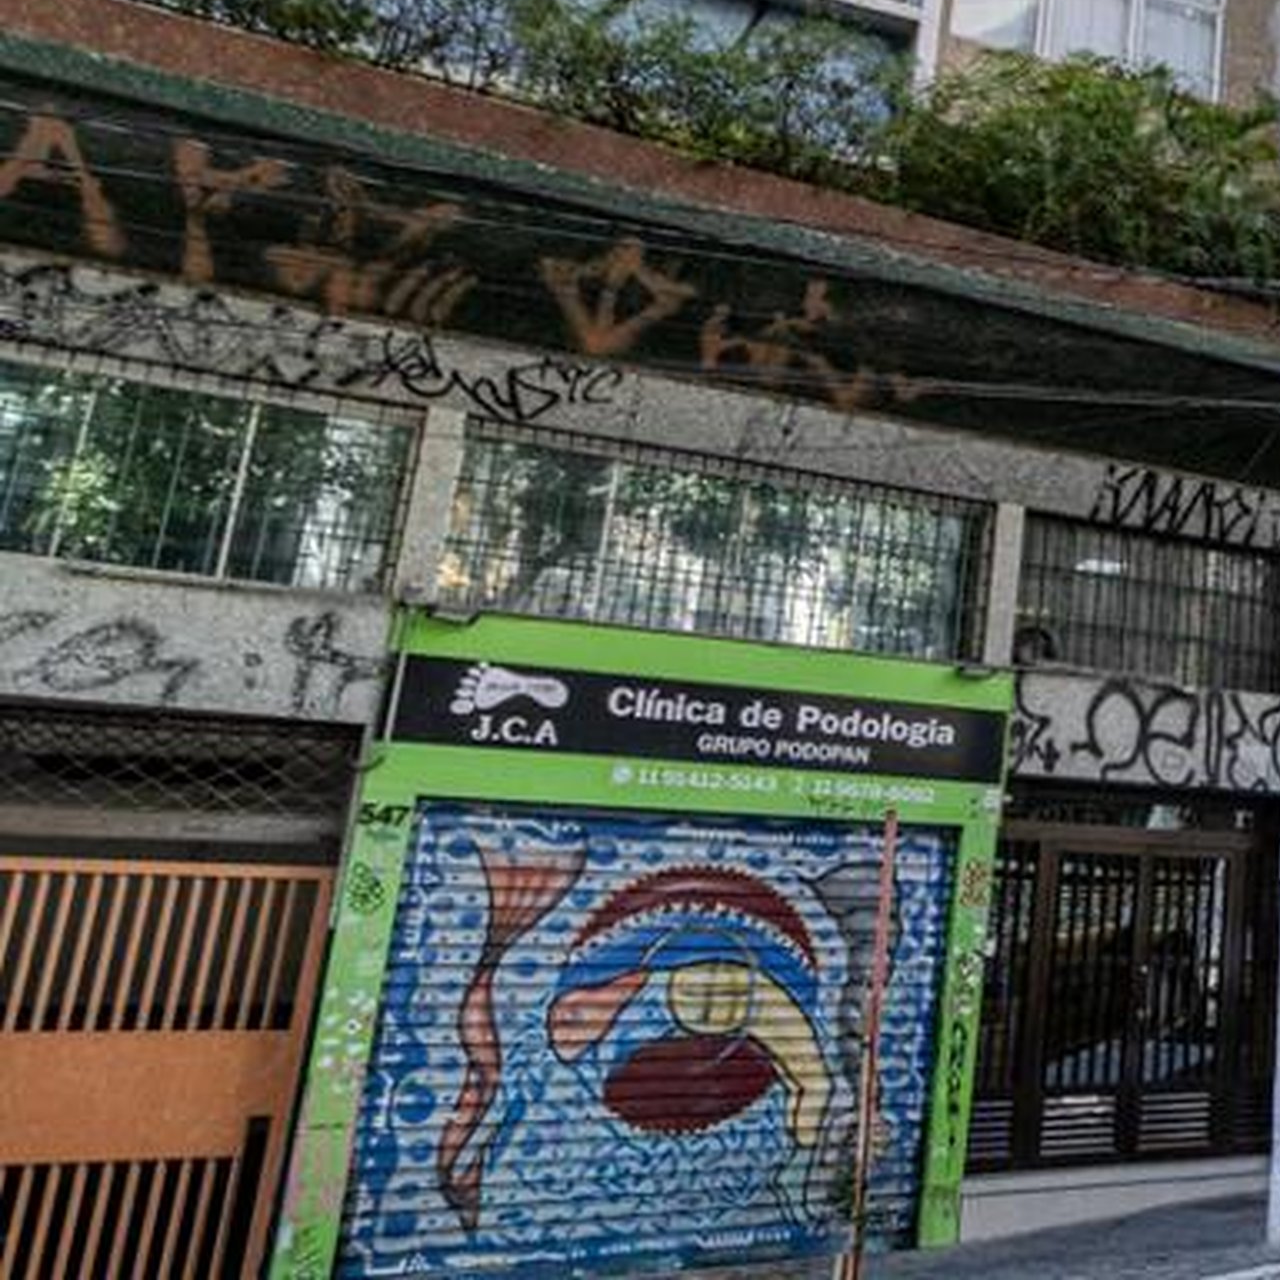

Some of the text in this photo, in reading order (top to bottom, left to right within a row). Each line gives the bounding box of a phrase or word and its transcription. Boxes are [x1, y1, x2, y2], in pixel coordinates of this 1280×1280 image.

[608, 686, 955, 747] Clínica de Podologia
[697, 734, 770, 758] GRUPO
[357, 802, 411, 827] 547
